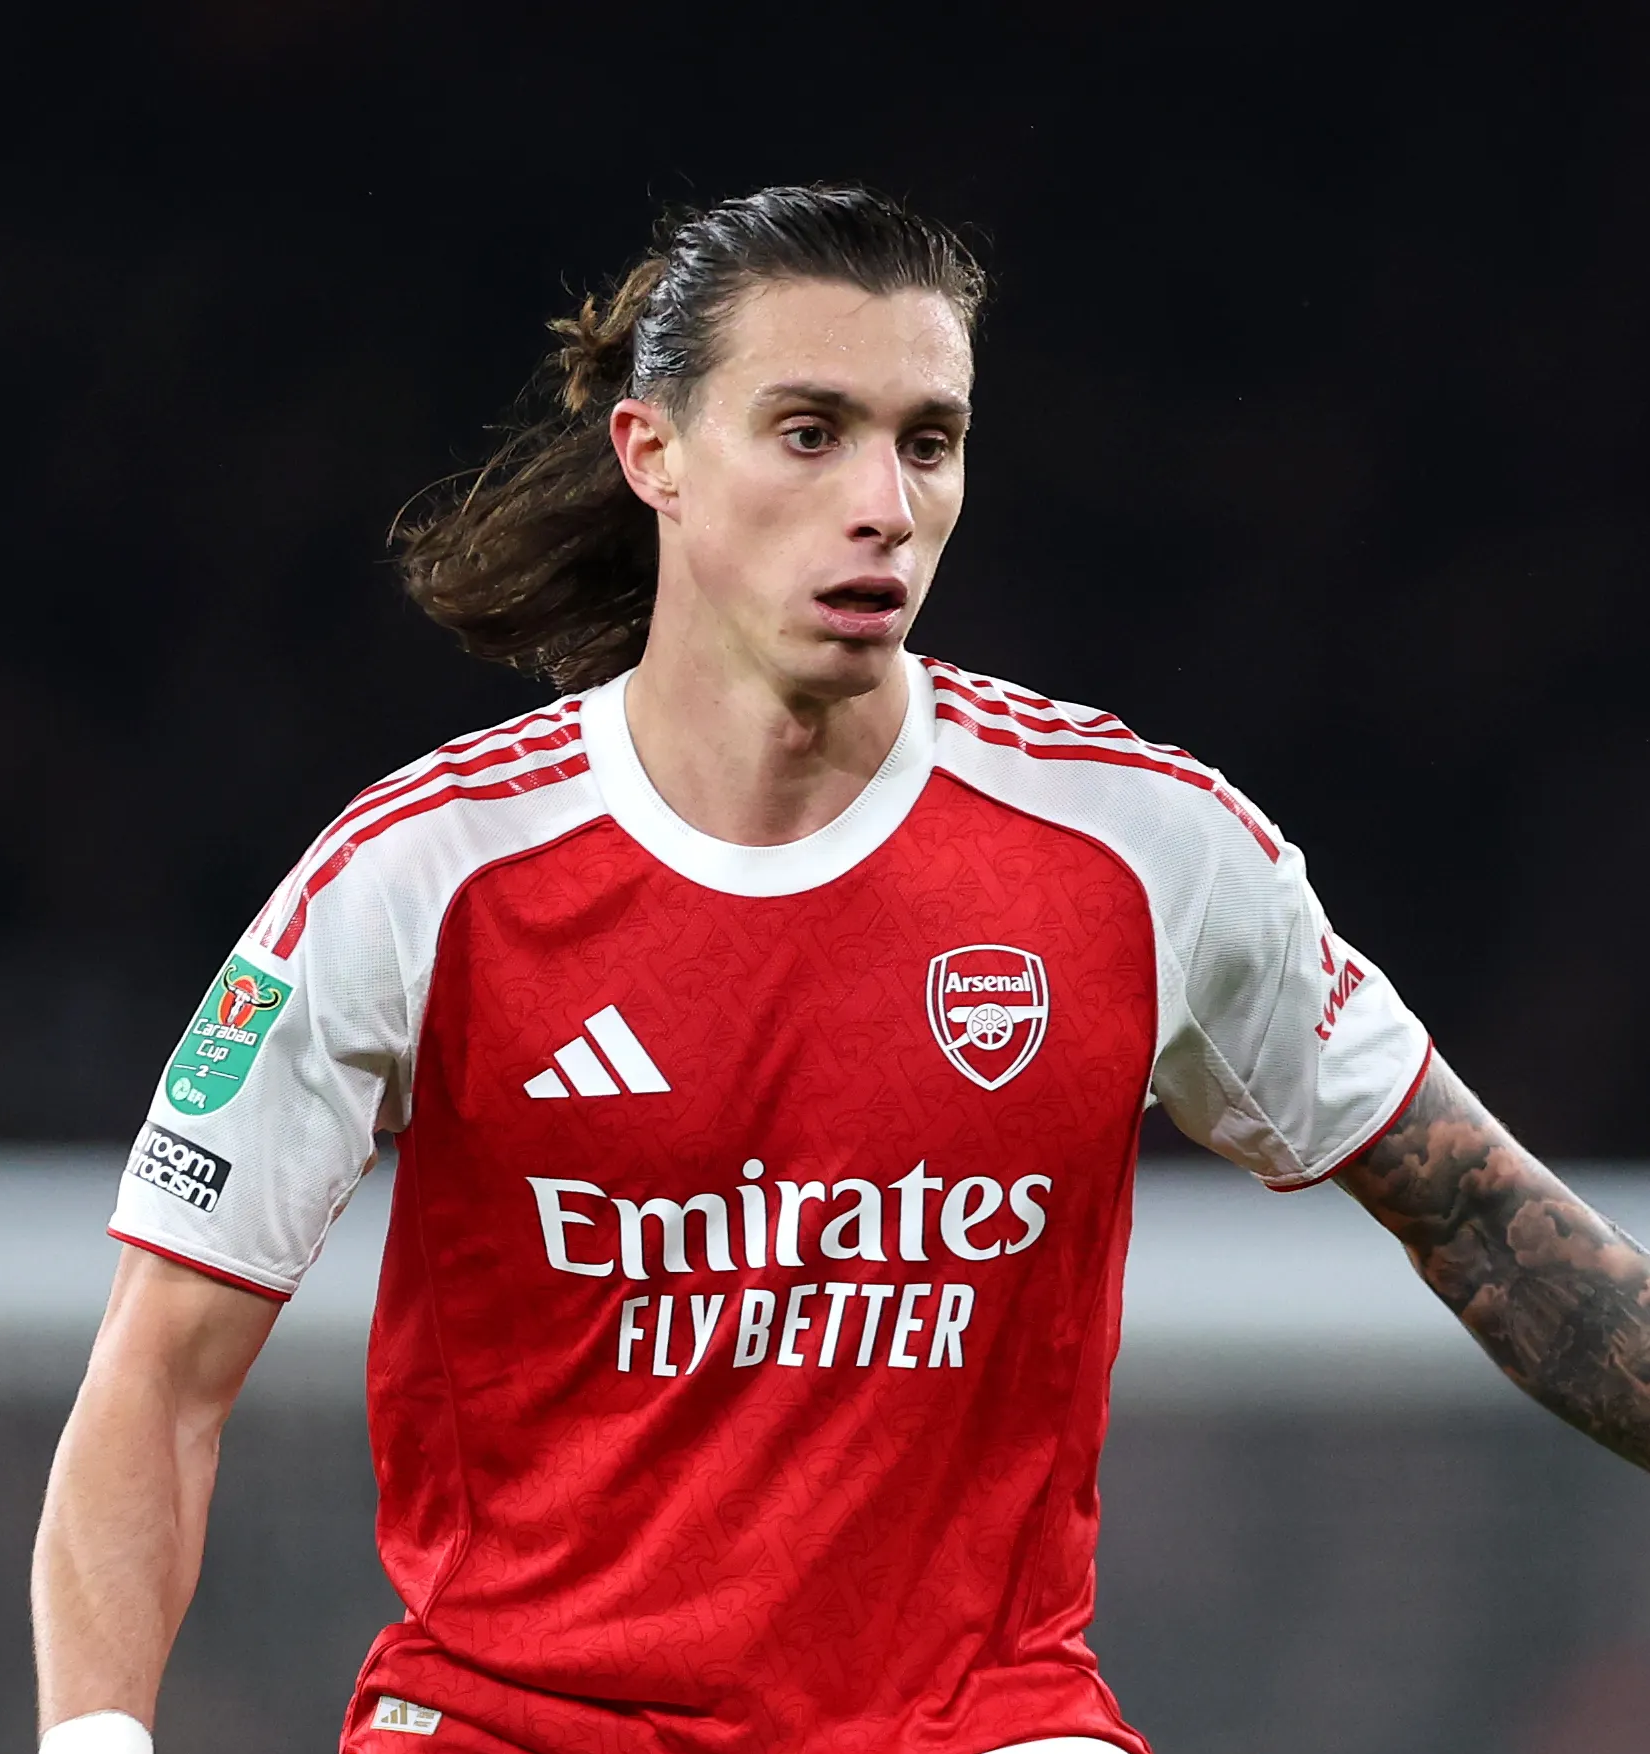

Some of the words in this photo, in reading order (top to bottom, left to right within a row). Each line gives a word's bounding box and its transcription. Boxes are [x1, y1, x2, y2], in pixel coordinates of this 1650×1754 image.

[945, 971, 1031, 993] Arsenal
[192, 1018, 258, 1046] Carabao
[196, 1039, 229, 1062] Cup
[195, 1065, 209, 1077] 2
[187, 1088, 207, 1109] EFL
[145, 1131, 216, 1182] room
[132, 1153, 218, 1211] racism
[524, 1158, 1052, 1280] Emirates
[617, 1294, 724, 1377] FLY
[733, 1282, 975, 1369] BETTER
